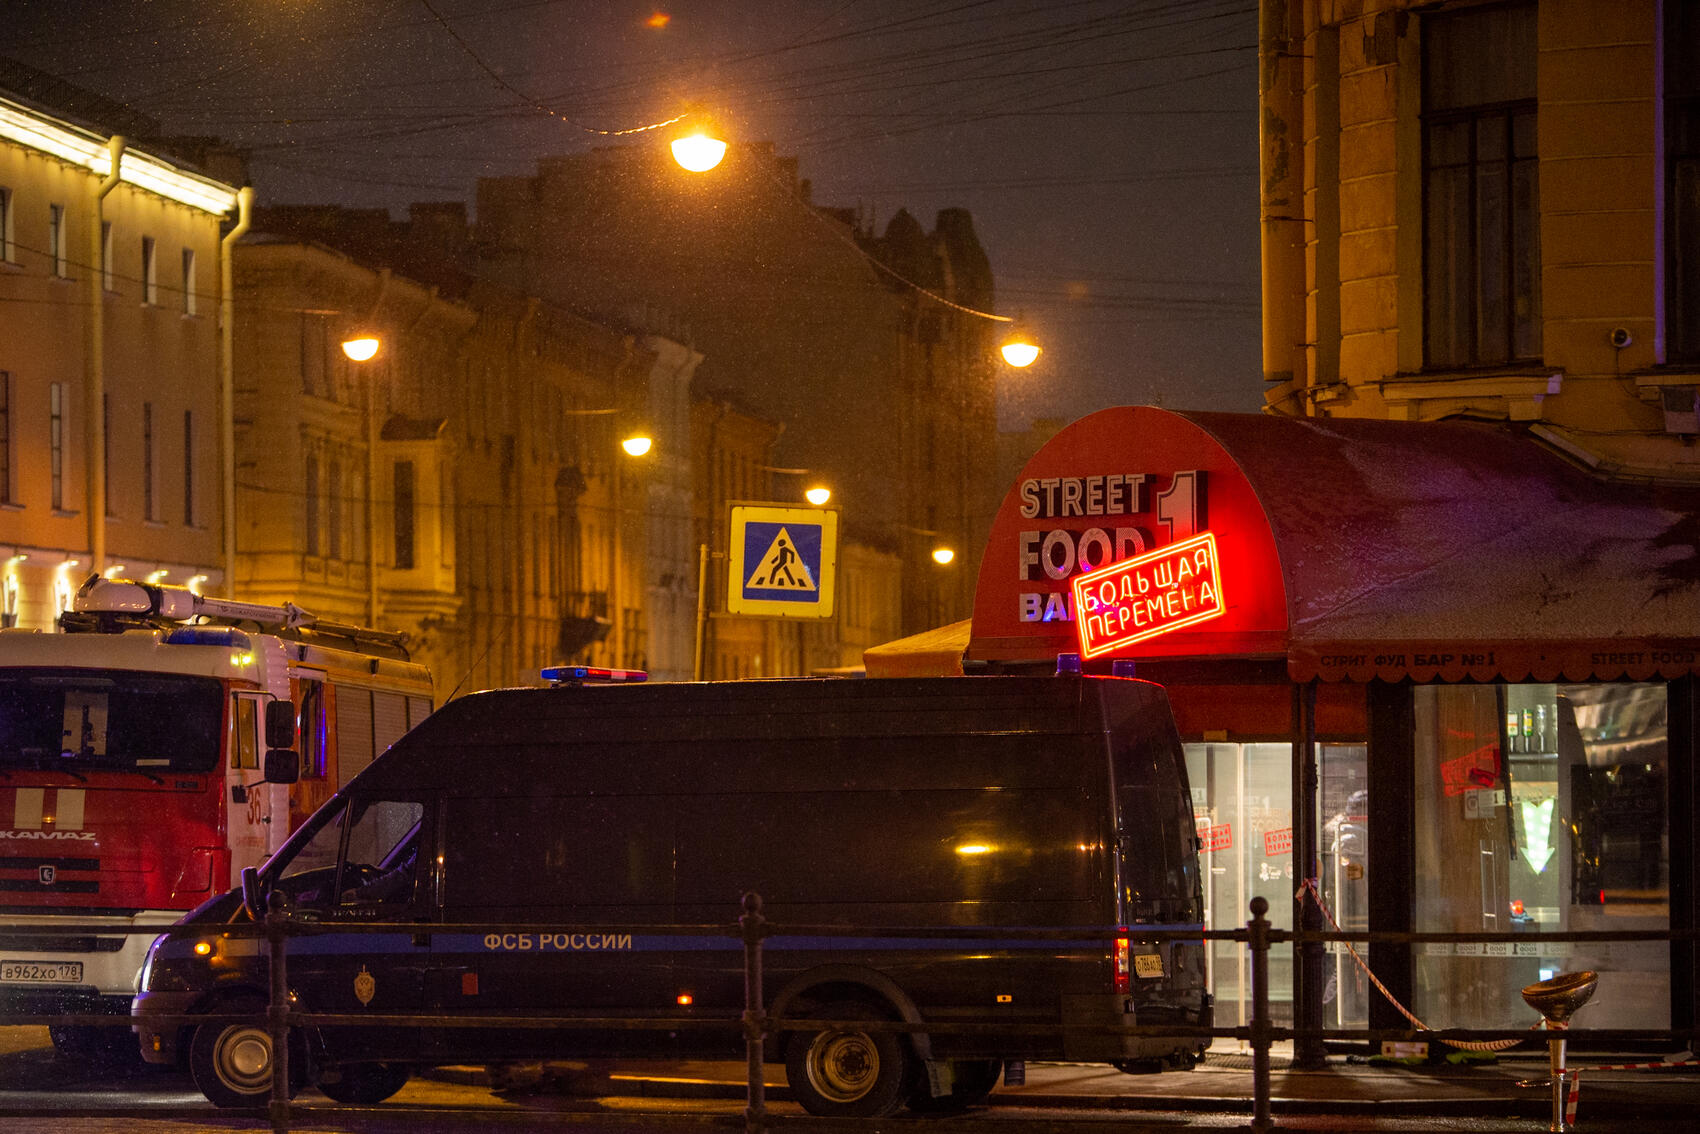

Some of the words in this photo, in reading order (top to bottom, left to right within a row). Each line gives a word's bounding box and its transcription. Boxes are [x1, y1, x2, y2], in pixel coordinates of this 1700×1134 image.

[1020, 474, 1146, 519] STREET
[1083, 548, 1209, 611] БОЛЬШАЯ
[1088, 581, 1216, 641] ПЕРЕМЕНА
[1320, 654, 1367, 666] СТРИТ
[1374, 654, 1406, 667] ФУД
[1414, 653, 1454, 666] БАР
[1591, 652, 1644, 665] STREET
[247, 787, 261, 825] 36
[484, 933, 532, 950] ФСБ
[539, 933, 632, 950] РОССИИ
